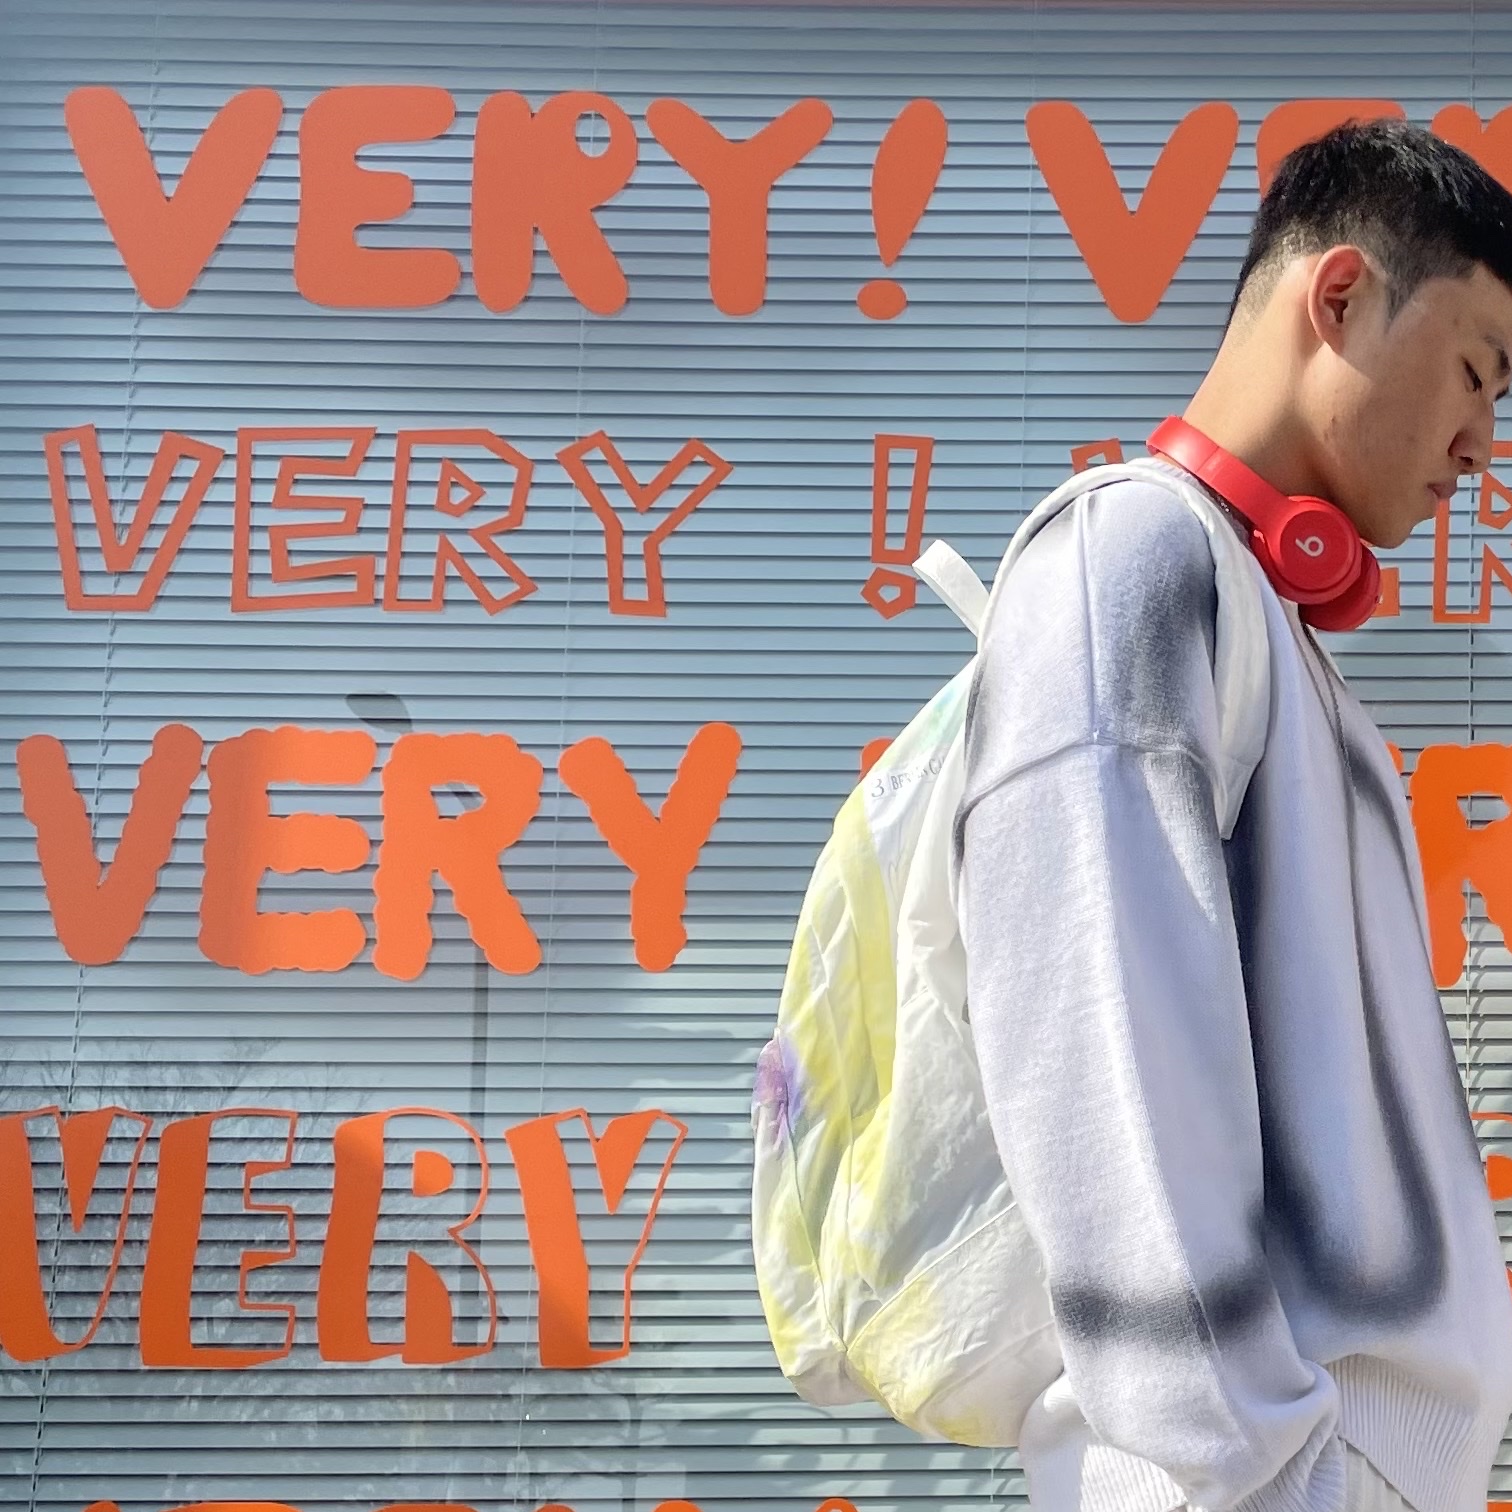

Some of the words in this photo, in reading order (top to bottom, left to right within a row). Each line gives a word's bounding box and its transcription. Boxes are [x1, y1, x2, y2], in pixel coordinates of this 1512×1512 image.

[64, 86, 948, 320] VERY!
[16, 721, 743, 980] VERY
[0, 1106, 689, 1370] VERY
